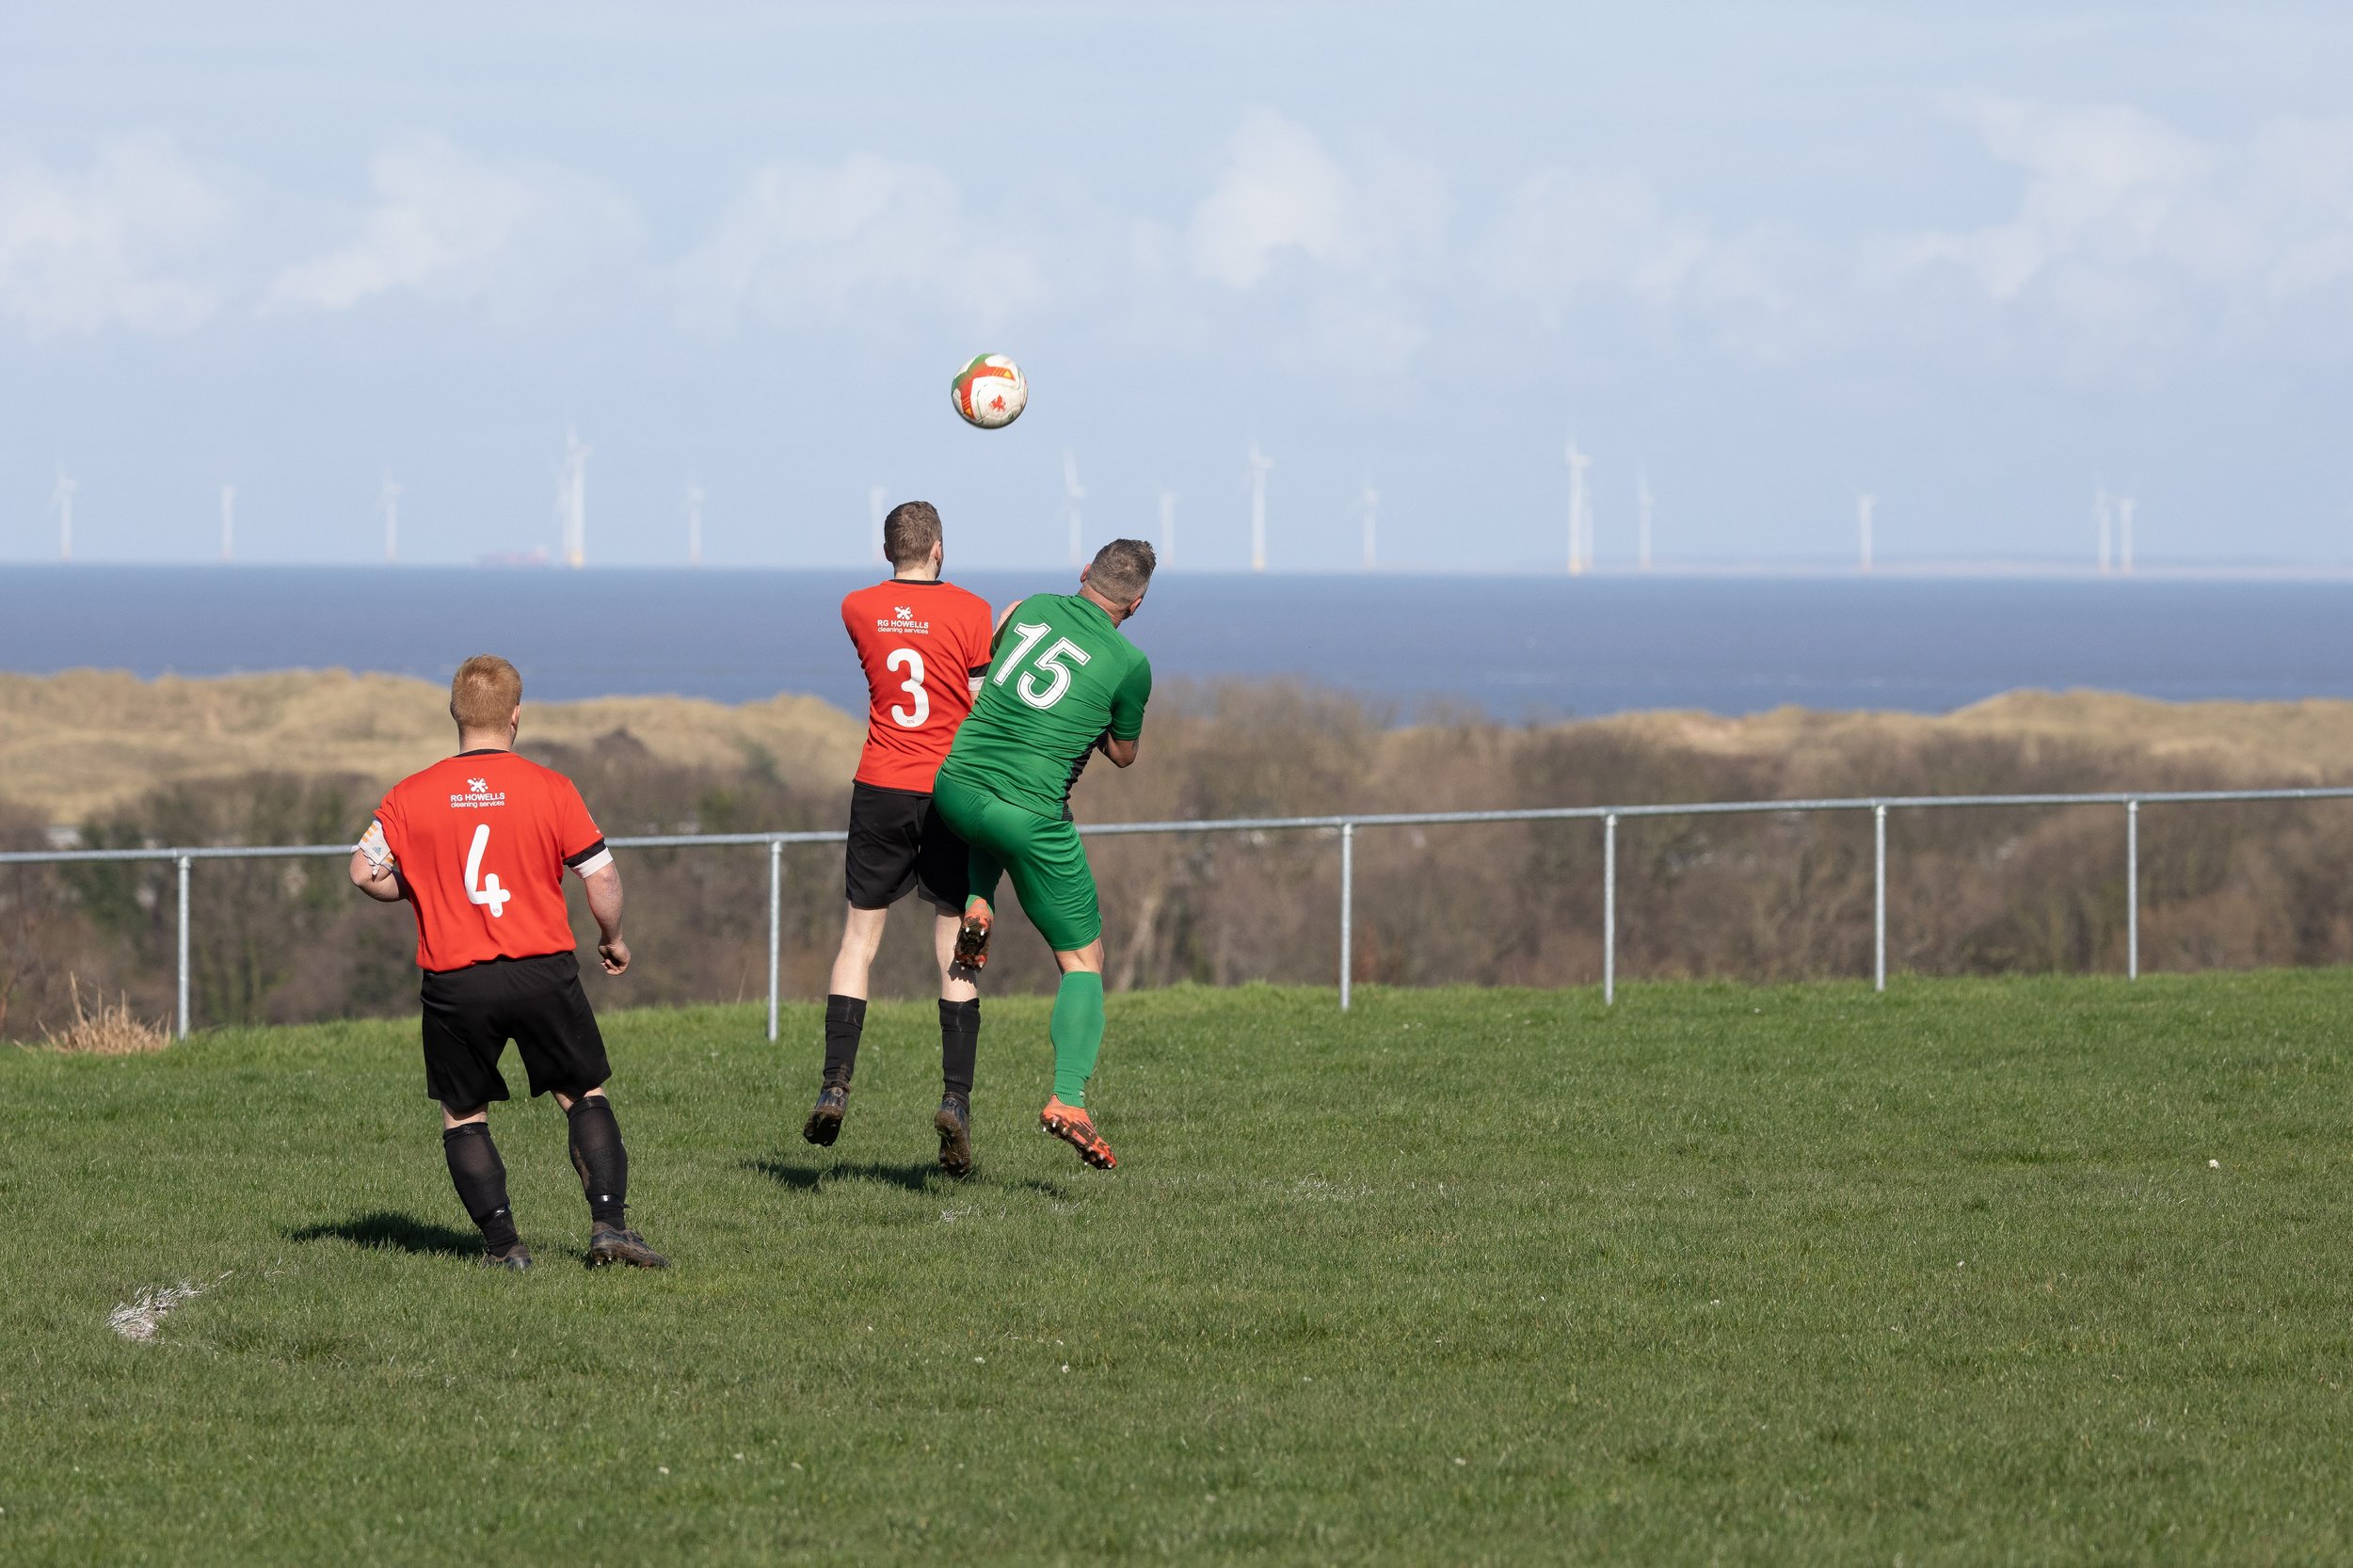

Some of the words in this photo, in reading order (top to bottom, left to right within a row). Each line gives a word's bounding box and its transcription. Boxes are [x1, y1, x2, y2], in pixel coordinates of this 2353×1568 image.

[877, 626, 904, 634] cleaning
[890, 619, 929, 630] HOWELLS
[991, 621, 1093, 712] 15
[886, 648, 930, 728] 3
[464, 792, 505, 801] HOWELLS
[451, 801, 478, 809] cleaning
[464, 824, 512, 919] 4
